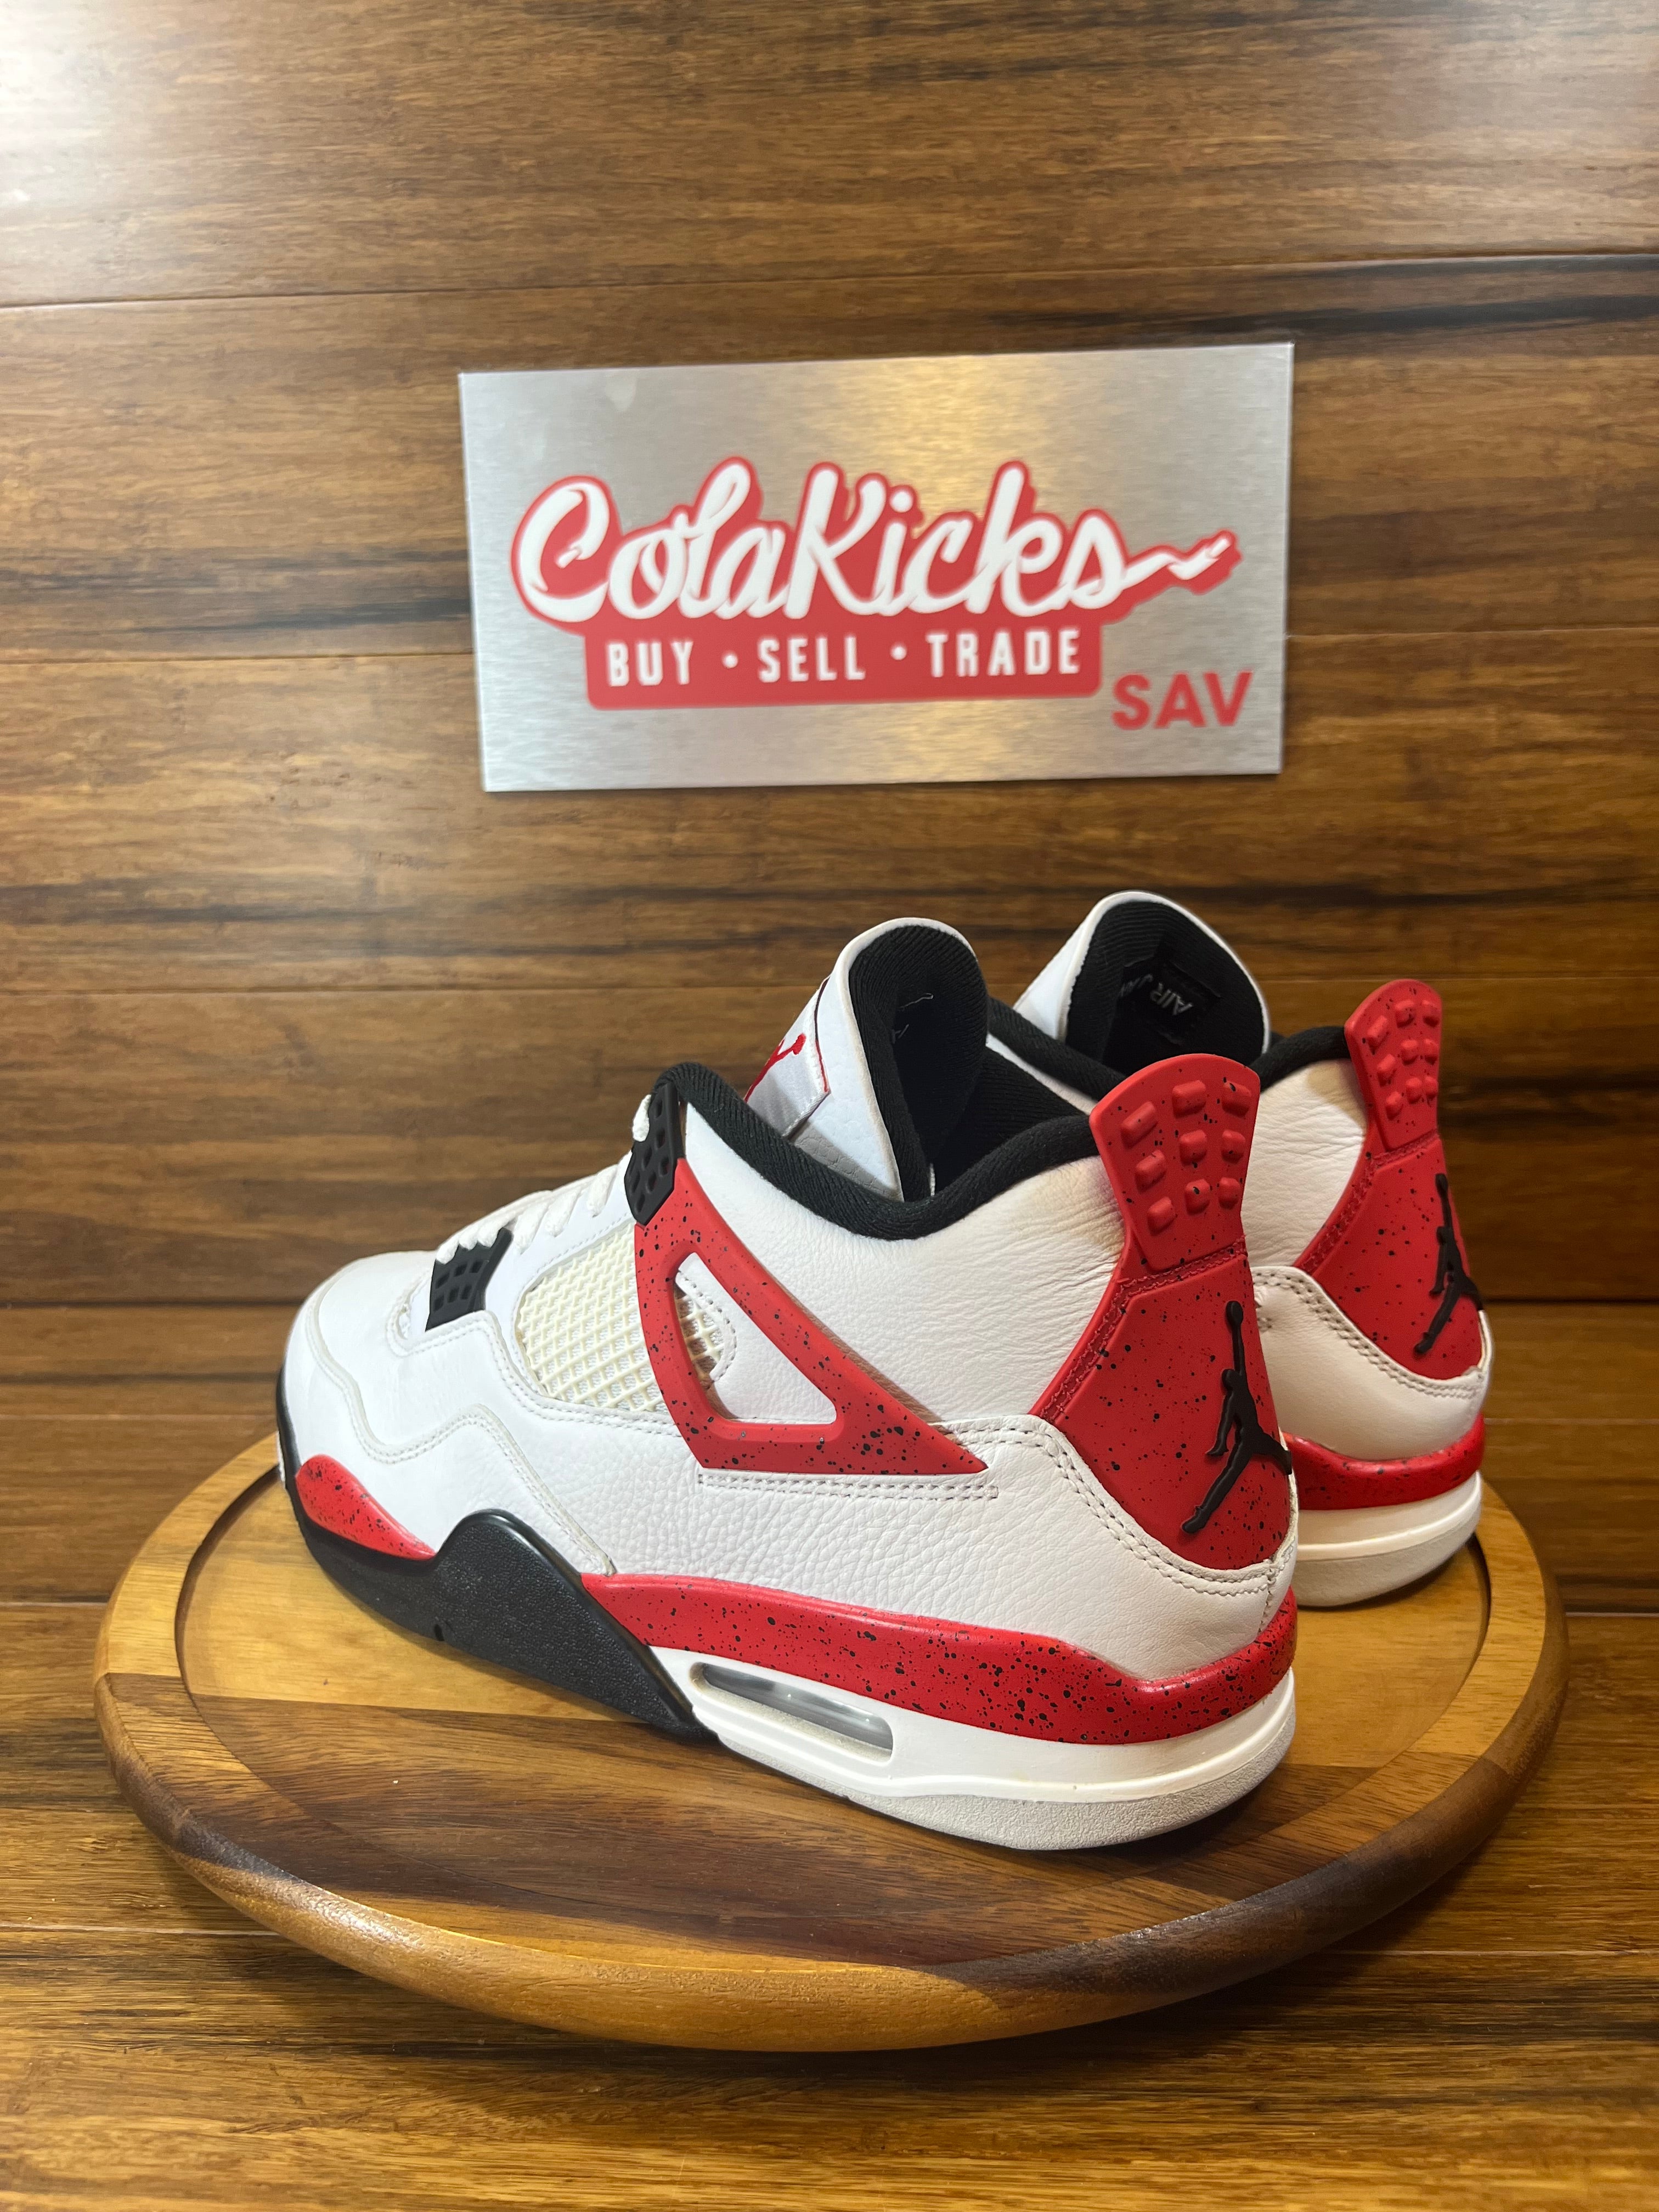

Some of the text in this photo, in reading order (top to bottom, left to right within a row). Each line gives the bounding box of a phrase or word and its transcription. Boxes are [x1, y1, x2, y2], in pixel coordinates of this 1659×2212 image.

[518, 464, 1232, 622] ColaKicks
[606, 639, 693, 687] BUY
[757, 635, 866, 683] SELL
[926, 628, 1080, 678] TRADE
[1111, 670, 1254, 731] SAV
[1150, 981, 1194, 1016] AIR
